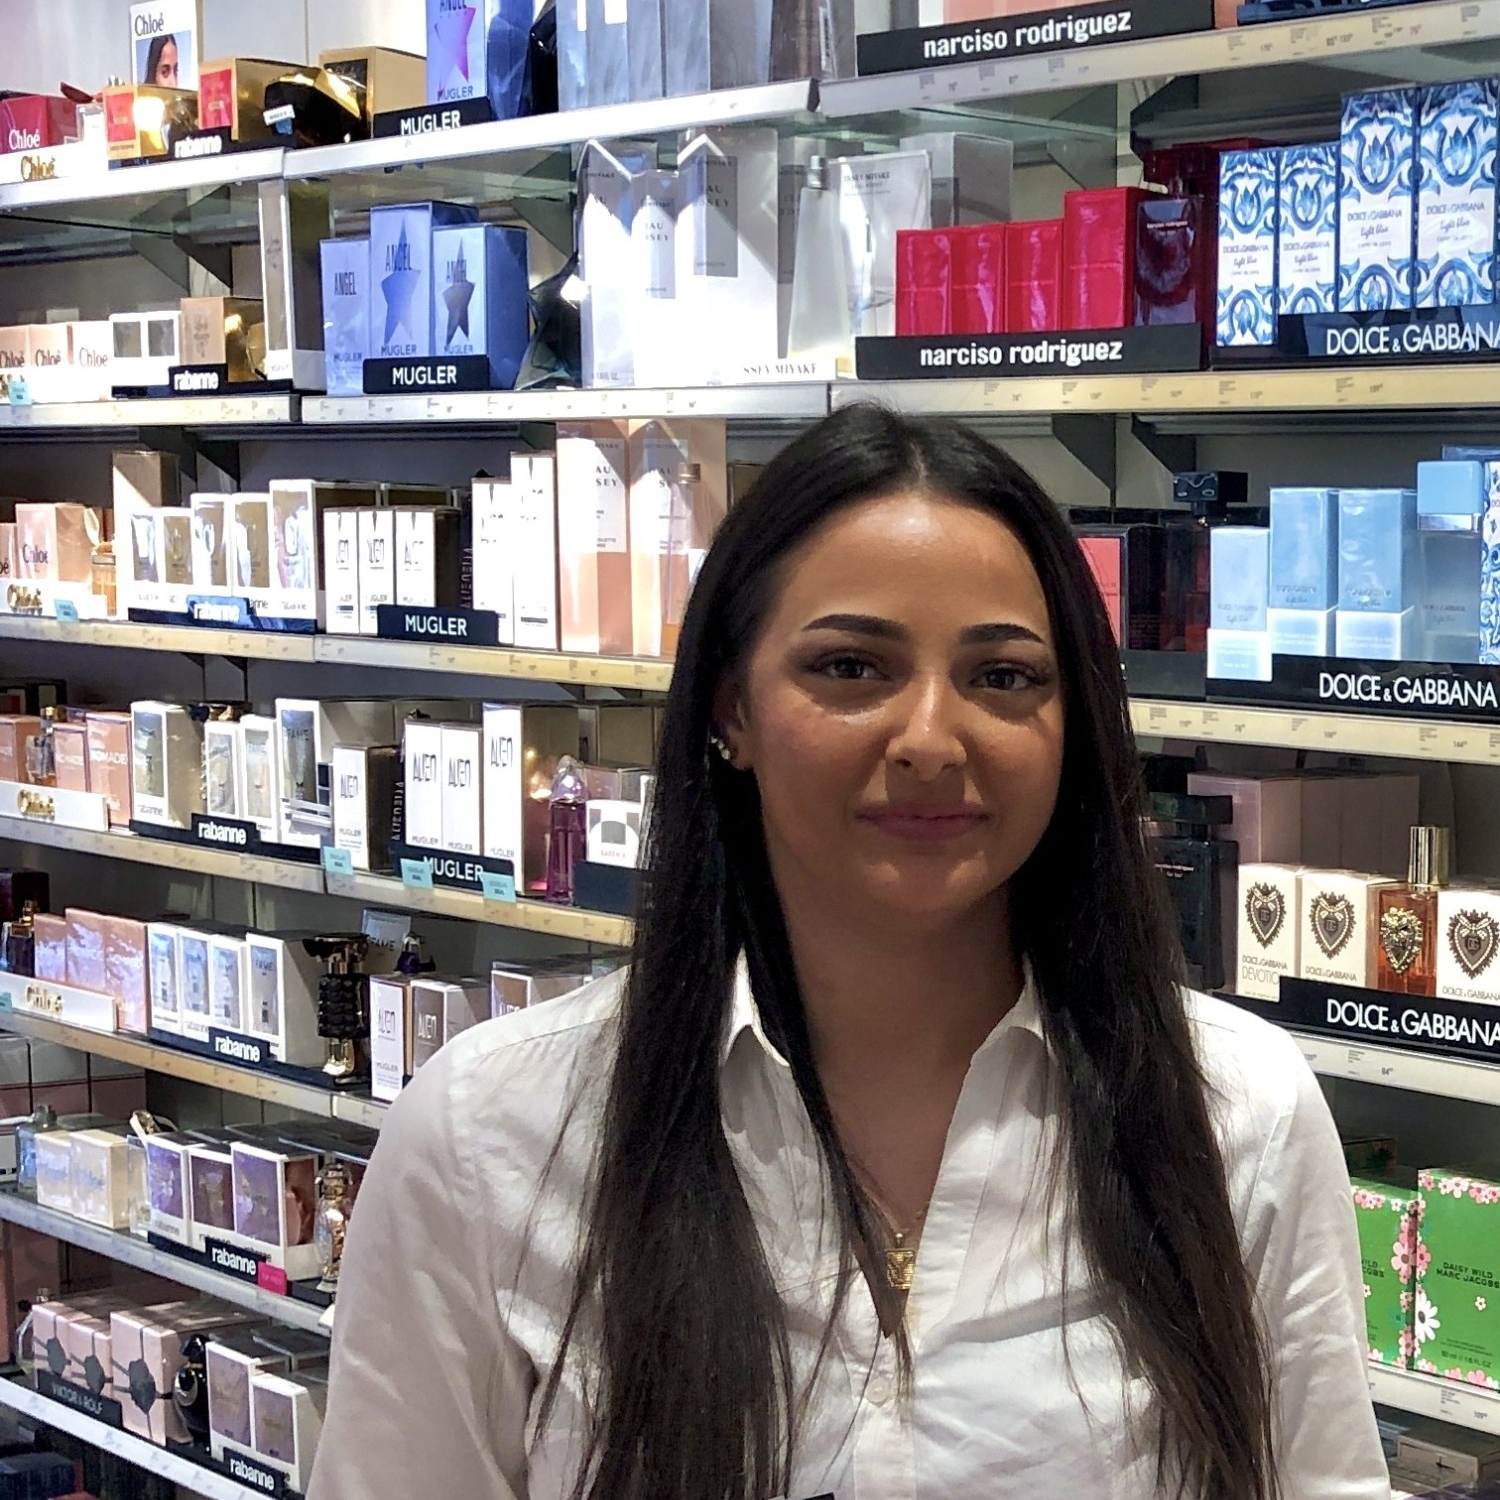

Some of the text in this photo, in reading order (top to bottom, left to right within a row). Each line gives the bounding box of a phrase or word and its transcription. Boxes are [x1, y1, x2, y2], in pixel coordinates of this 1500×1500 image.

[135, 13, 164, 37] Chloé
[924, 11, 1132, 59] narciso rodriguez
[401, 111, 462, 136] MUGLER
[9, 130, 41, 150] Chloé
[174, 135, 222, 157] rabanne
[920, 339, 1123, 367] narciso rodriguez
[174, 369, 219, 390] rabanne
[393, 366, 456, 386] MUGLER
[405, 615, 467, 636] MUGLER
[198, 824, 246, 845] rabanne
[412, 836, 439, 844] MUGLER
[448, 842, 473, 851] MUGLER
[424, 856, 485, 881] MUGLER
[1242, 966, 1280, 985] DEVOTIO
[215, 1036, 261, 1061] rabanne
[212, 1246, 256, 1275] rabanne
[1443, 1261, 1493, 1279] DAISY WILD
[1436, 1268, 1500, 1289] MARC JACOBS
[230, 1458, 274, 1490] rabanne
